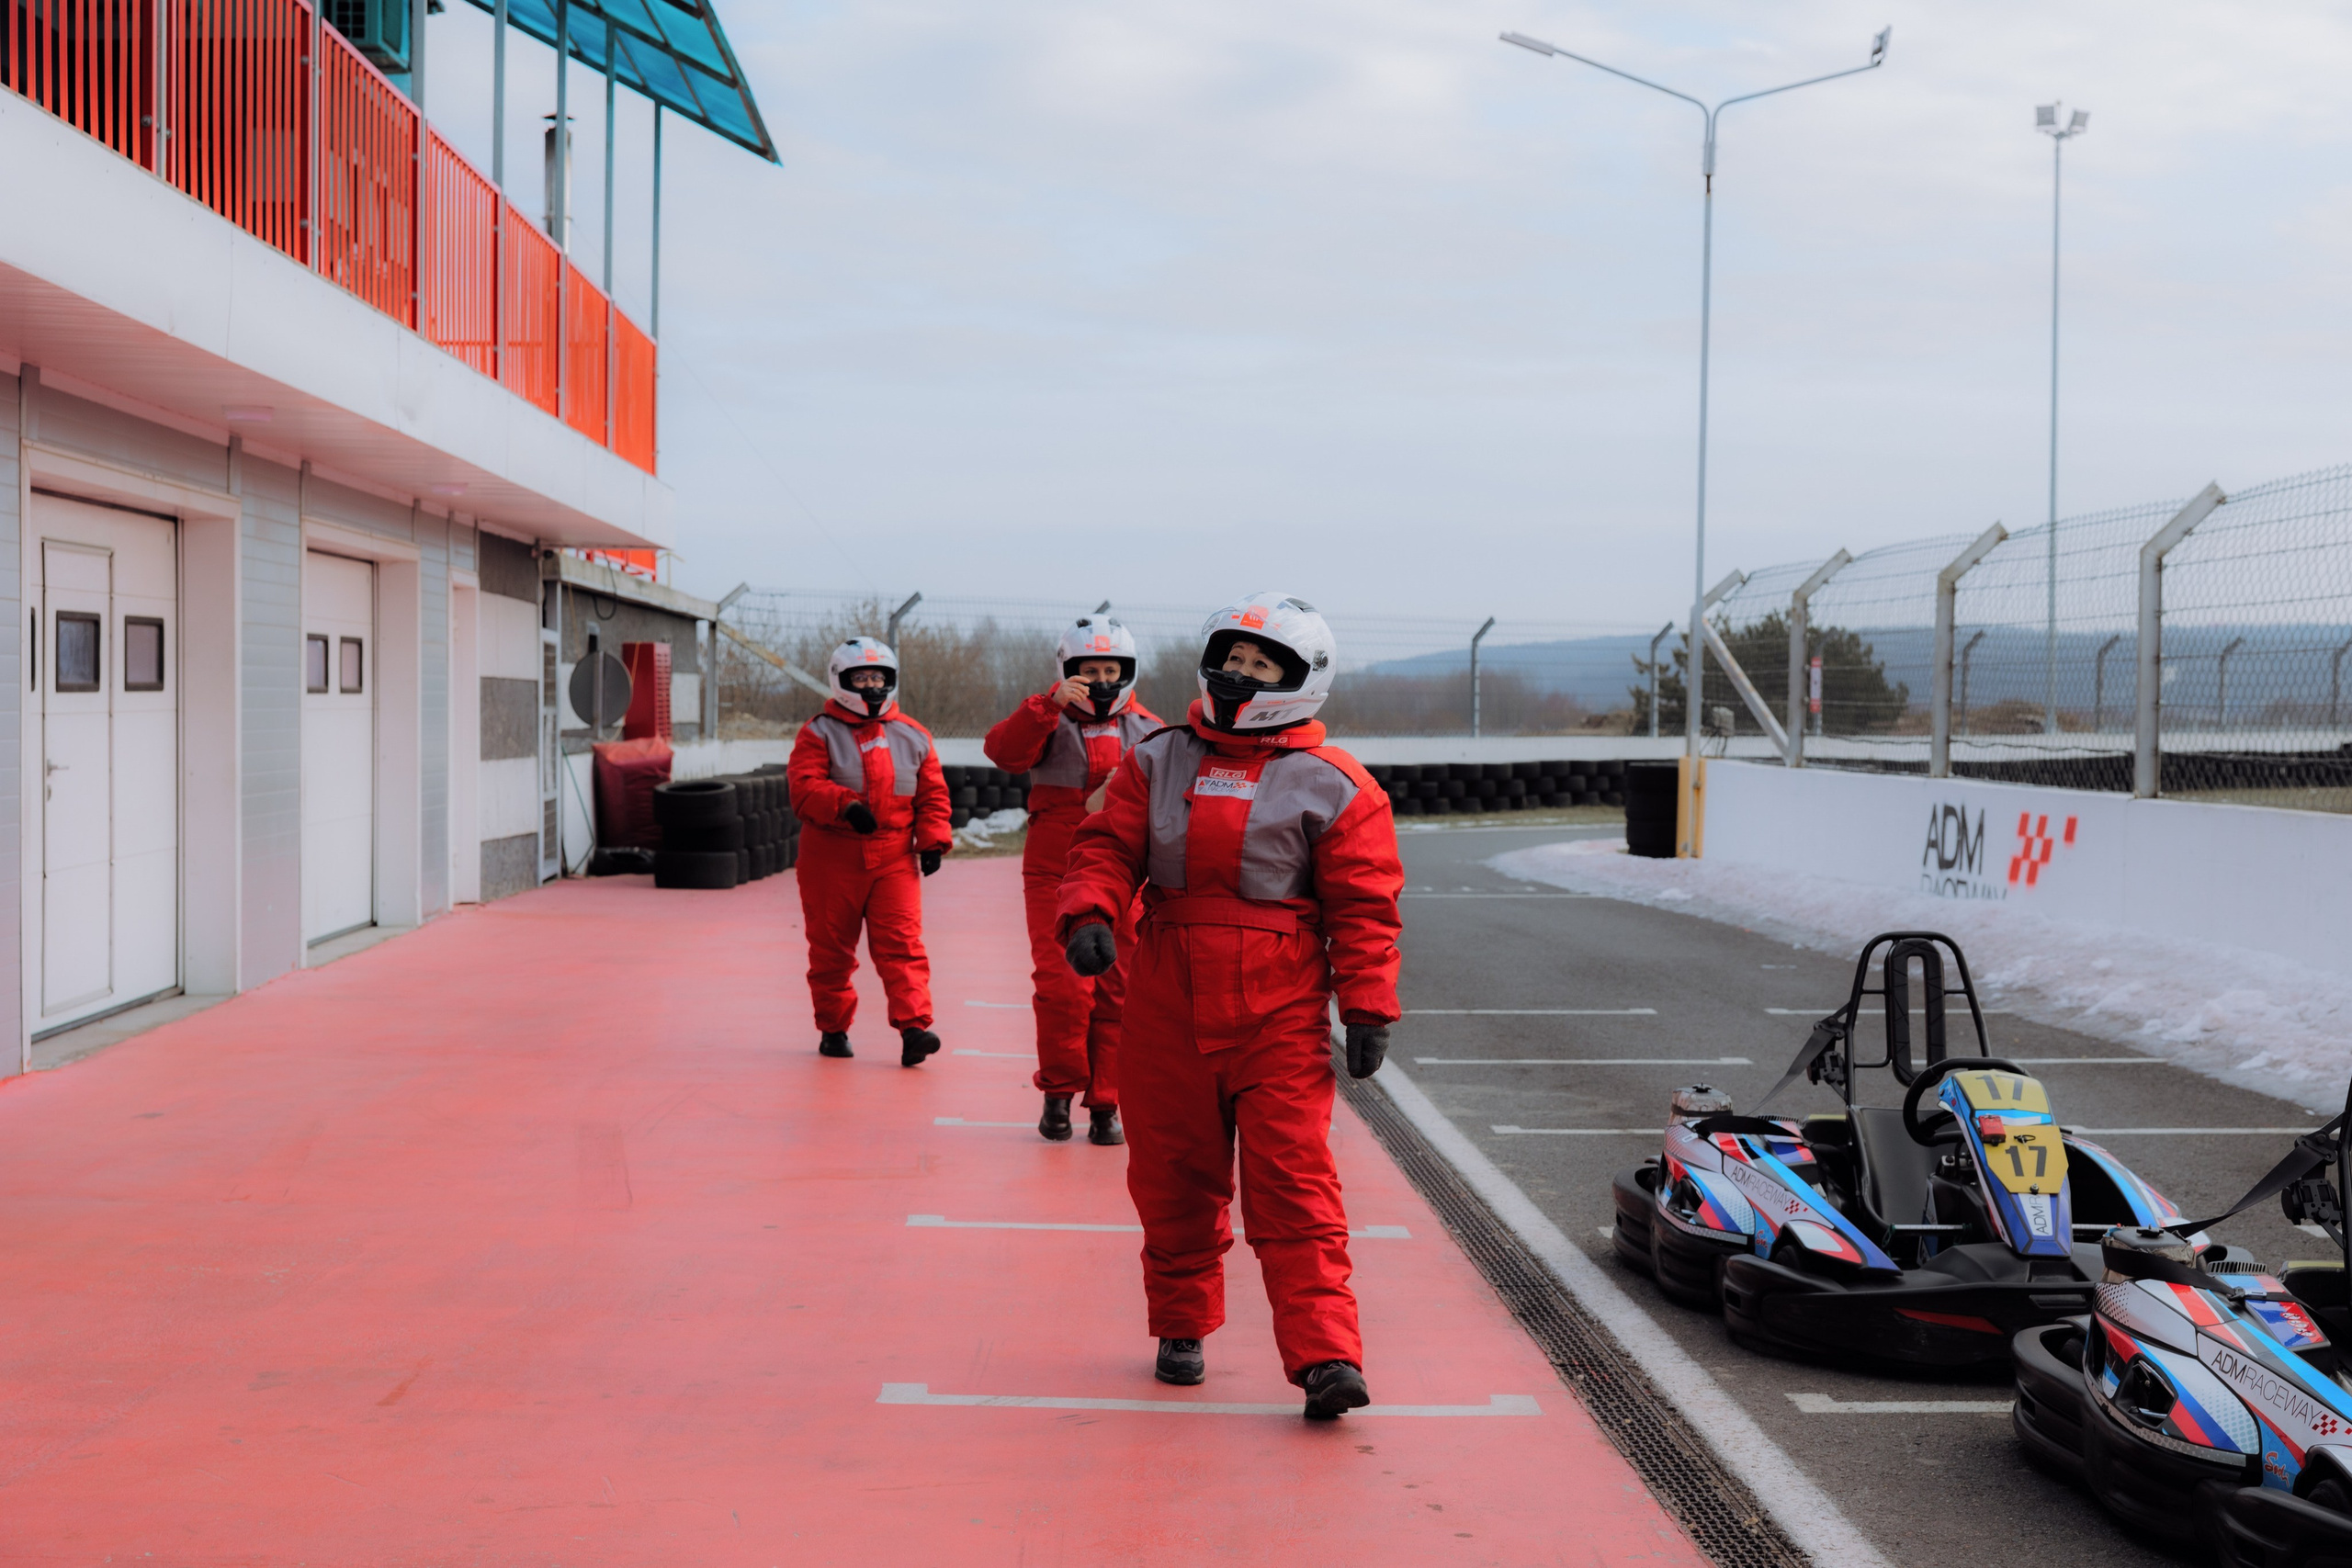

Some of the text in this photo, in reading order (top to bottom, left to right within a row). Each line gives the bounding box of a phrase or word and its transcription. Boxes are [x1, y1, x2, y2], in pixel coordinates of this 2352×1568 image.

[1249, 705, 1302, 722] MT
[1209, 780, 1234, 789] ADM
[1213, 770, 1243, 779] RLG
[1923, 804, 1984, 875] ADM
[1975, 1074, 2024, 1101] 17
[2005, 1145, 2047, 1178] 17
[2264, 1451, 2290, 1488] Sodi
